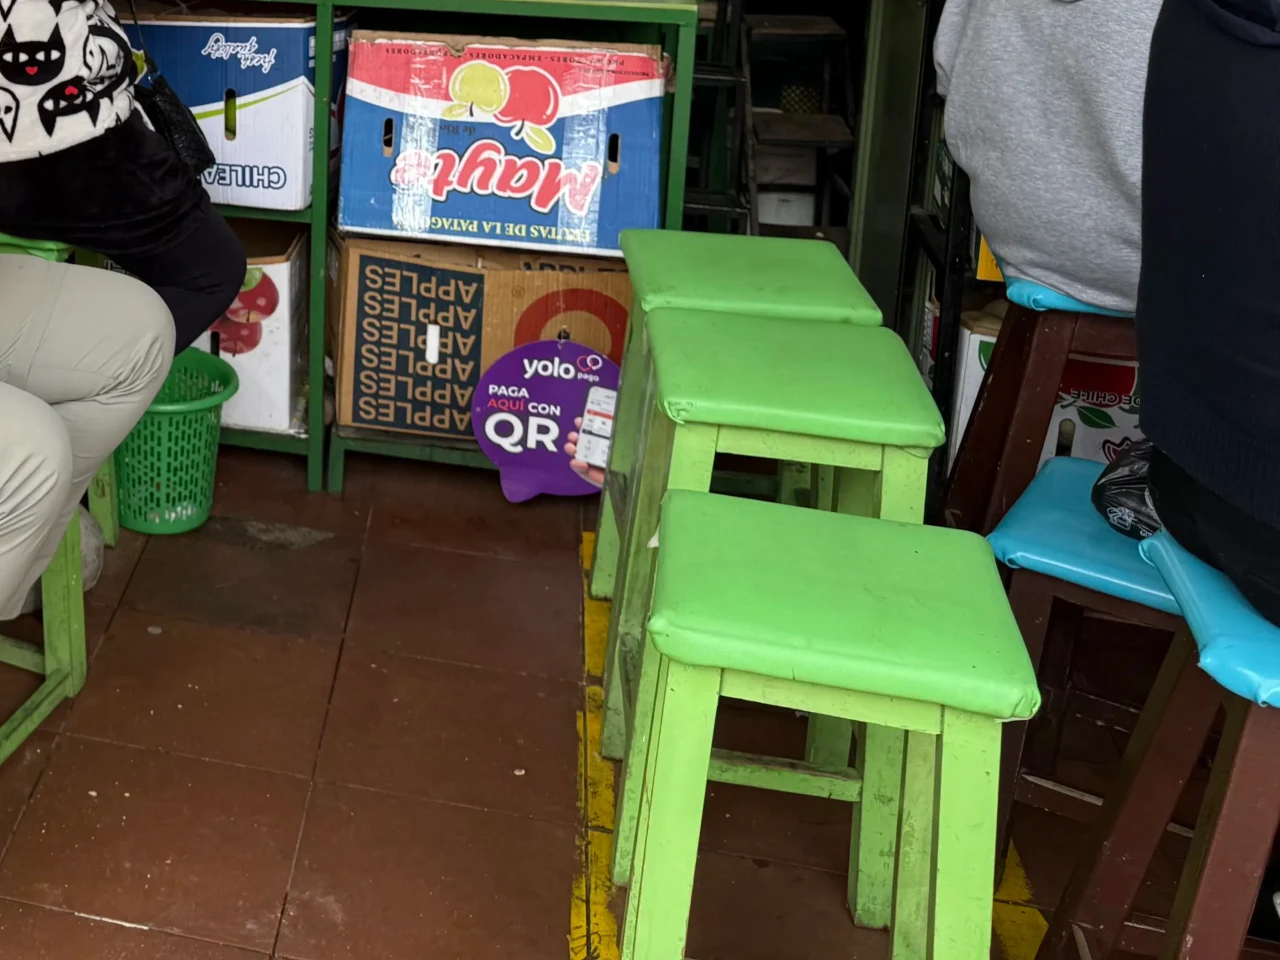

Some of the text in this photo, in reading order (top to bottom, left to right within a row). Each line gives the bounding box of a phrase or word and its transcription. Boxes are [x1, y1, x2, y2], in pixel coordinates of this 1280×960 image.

[200, 164, 287, 189] CHILEA
[482, 221, 590, 242] FRUTAS DE LA
[364, 264, 478, 304] APPLES
[363, 292, 477, 330] APPLES
[361, 344, 475, 382] APPLES
[523, 357, 575, 380] yolo
[577, 372, 599, 382] pago
[360, 370, 473, 406] APPLES
[488, 384, 529, 398] PAGA
[358, 397, 472, 431] APPLES
[487, 398, 561, 416] AQUÍ CON
[484, 412, 560, 453] QR
